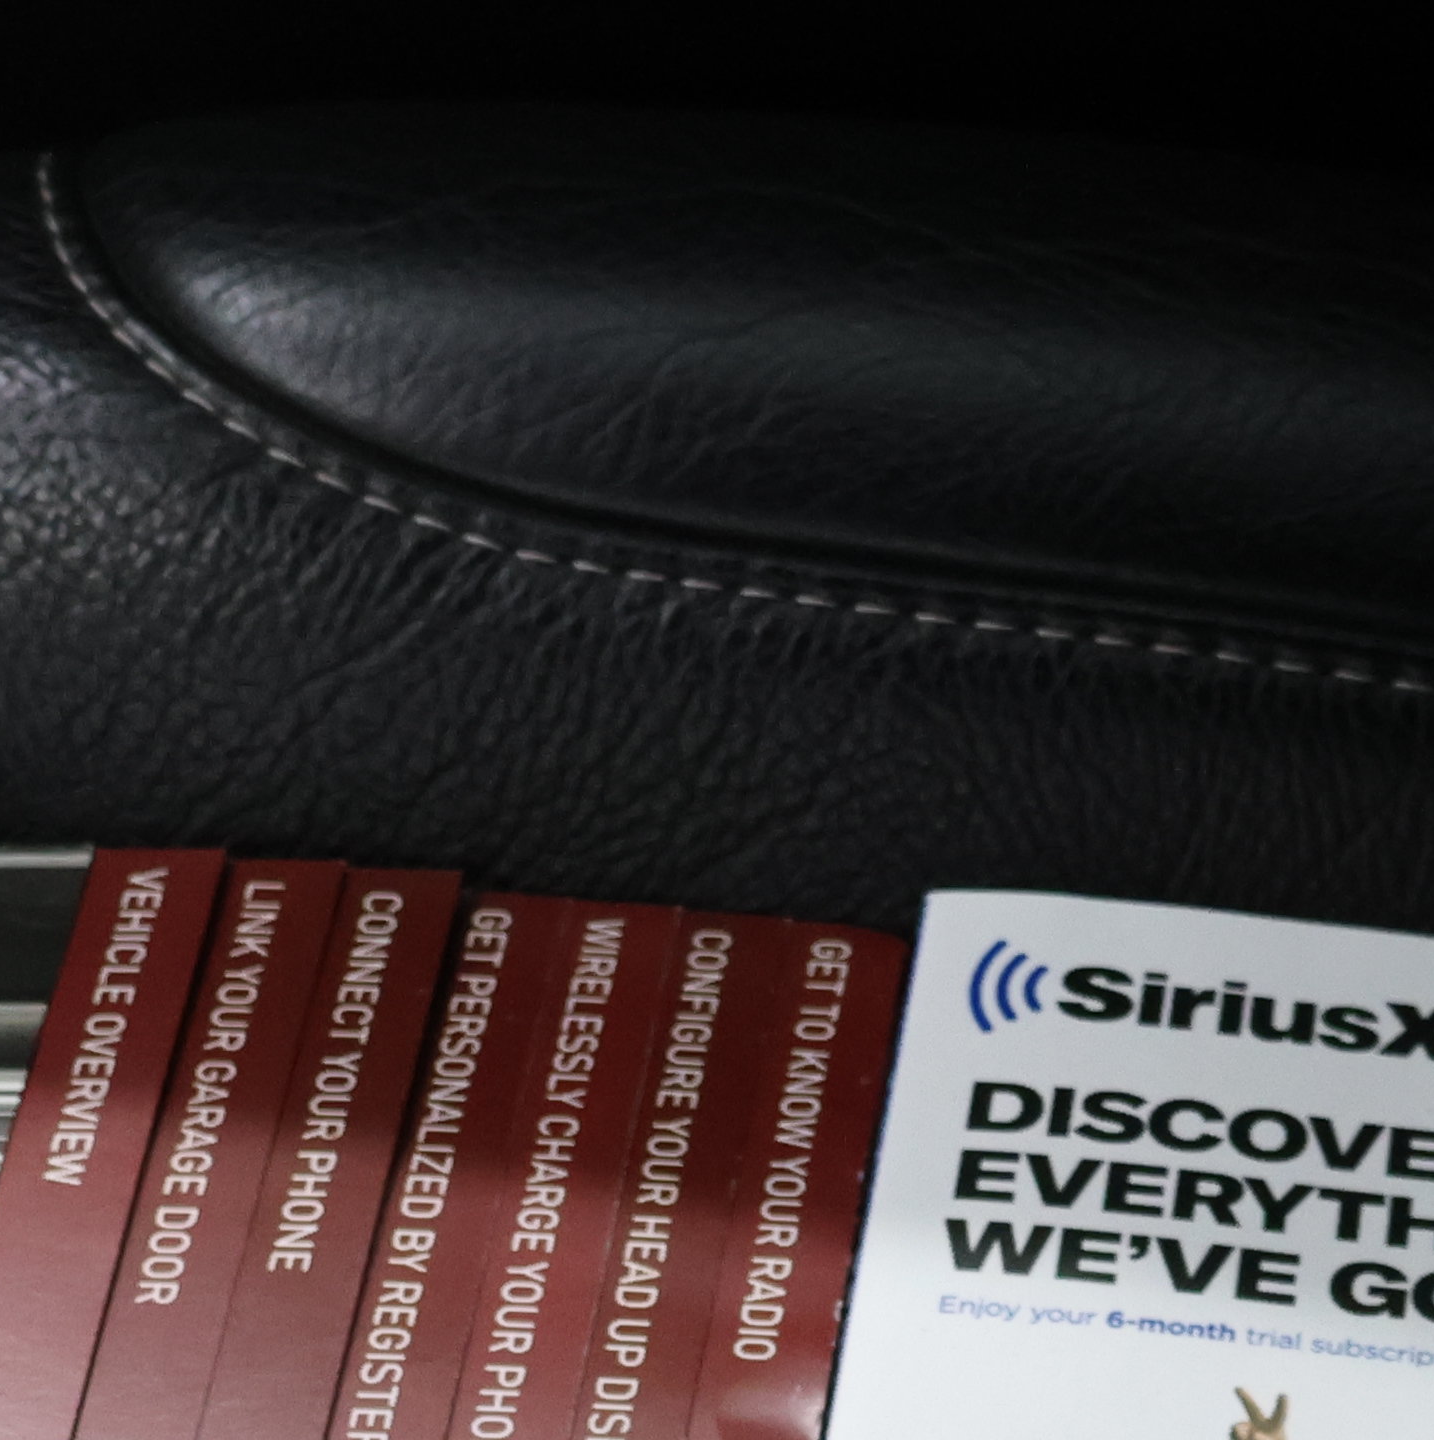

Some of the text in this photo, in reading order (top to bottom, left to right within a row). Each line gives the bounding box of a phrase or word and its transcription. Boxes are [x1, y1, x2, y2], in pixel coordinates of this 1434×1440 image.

[464, 907, 513, 969] GET
[42, 866, 169, 1187] VEHICLE OVERVIEW
[545, 918, 625, 1109] WIRELESSLY
[655, 928, 733, 1110] CONFIGURE
[134, 878, 287, 1306] LINK YOUR GARAGE DOOR
[267, 890, 404, 1274] CONNECT YOUR PHONE
[400, 973, 498, 1219] PERSONALIZED
[510, 1114, 581, 1254] CHARGE
[635, 1116, 693, 1206] YOUR
[732, 937, 853, 1361] GET TO KNOW YOUR RADIO
[388, 1227, 436, 1274] BY
[489, 1261, 550, 1354] YOUR
[614, 1214, 673, 1309] HEAD
[944, 1217, 1298, 1307] WE'VE
[603, 1318, 652, 1368] UP
[938, 1294, 1020, 1322] Enjoy
[1030, 1304, 1097, 1327] your
[1106, 1309, 1237, 1343] 6-month
[1246, 1328, 1302, 1351] trial
